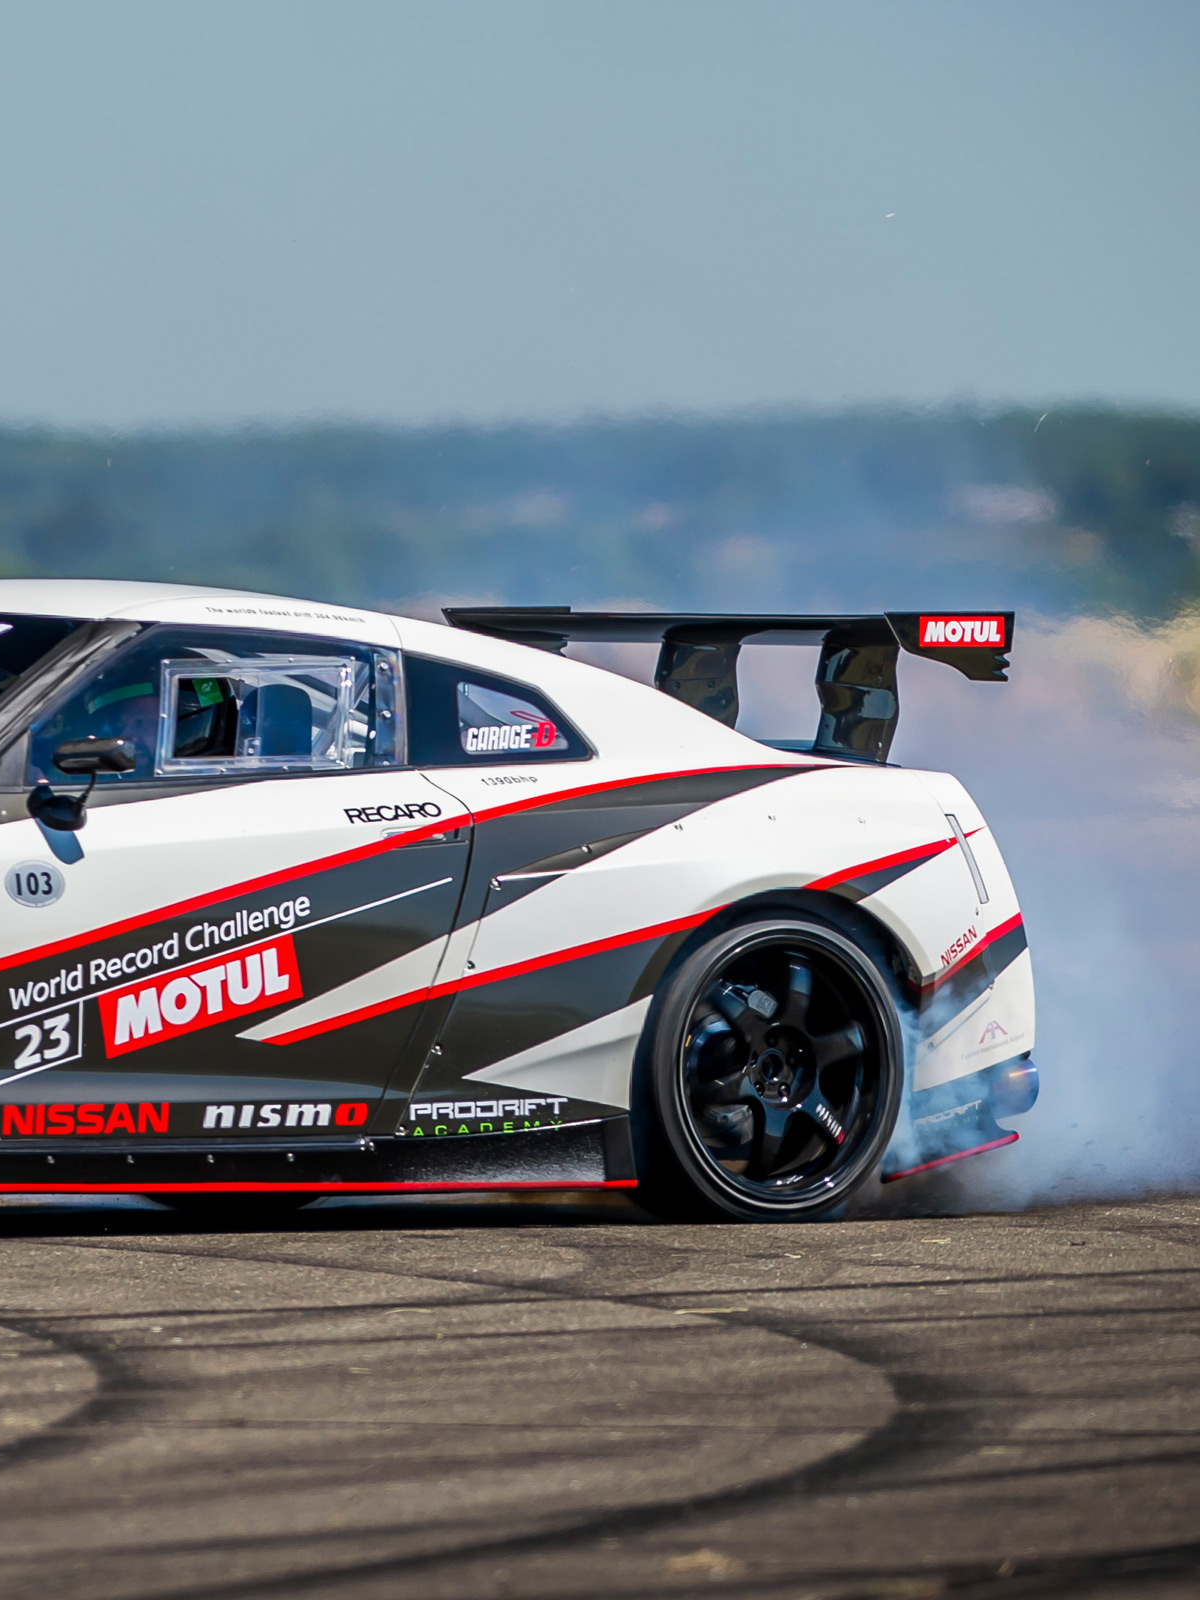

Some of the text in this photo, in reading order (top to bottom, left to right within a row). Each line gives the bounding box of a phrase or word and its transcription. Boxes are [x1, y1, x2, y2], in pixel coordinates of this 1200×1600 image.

[923, 620, 1001, 643] MOTUL
[465, 721, 556, 751] GARAGE-D
[481, 775, 538, 787] 1390bhp
[343, 802, 442, 824] RECARO
[15, 871, 53, 896] 103
[9, 896, 311, 1010] World Record Challenge
[940, 925, 978, 969] NISSAN
[114, 947, 290, 1046] MOTUL
[14, 1013, 71, 1070] 23
[2, 1102, 169, 1135] NISSAN
[202, 1103, 368, 1128] nismo
[409, 1097, 569, 1121] PRODRIFT
[412, 1120, 563, 1137] ACADEMY
